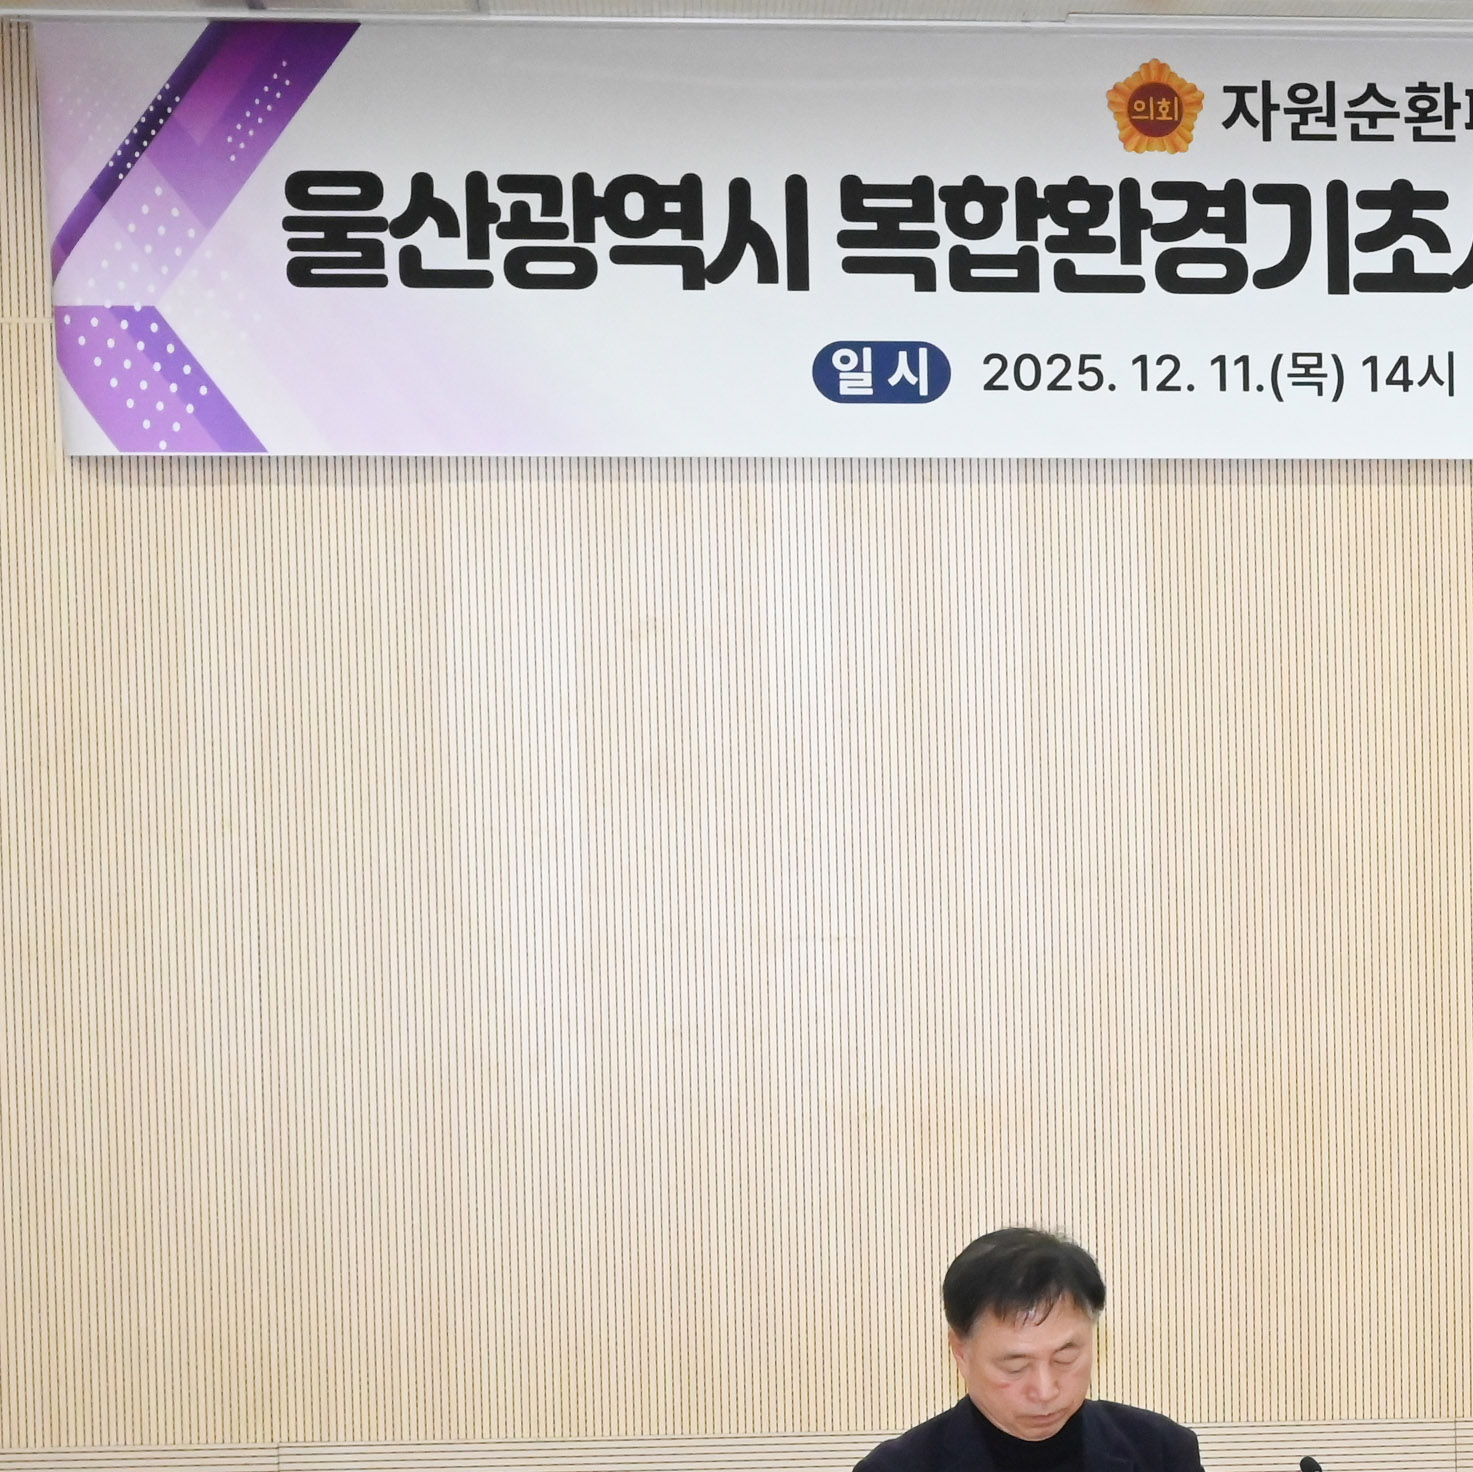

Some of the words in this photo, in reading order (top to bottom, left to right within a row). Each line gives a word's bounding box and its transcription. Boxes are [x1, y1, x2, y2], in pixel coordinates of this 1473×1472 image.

[1131, 96, 1178, 121] 의회
[282, 171, 809, 292] 울산광역시
[983, 353, 1115, 392] 2025.
[1132, 354, 1194, 391] 12.
[1211, 353, 1344, 402] 11.(목)
[1363, 351, 1454, 397] 14시
